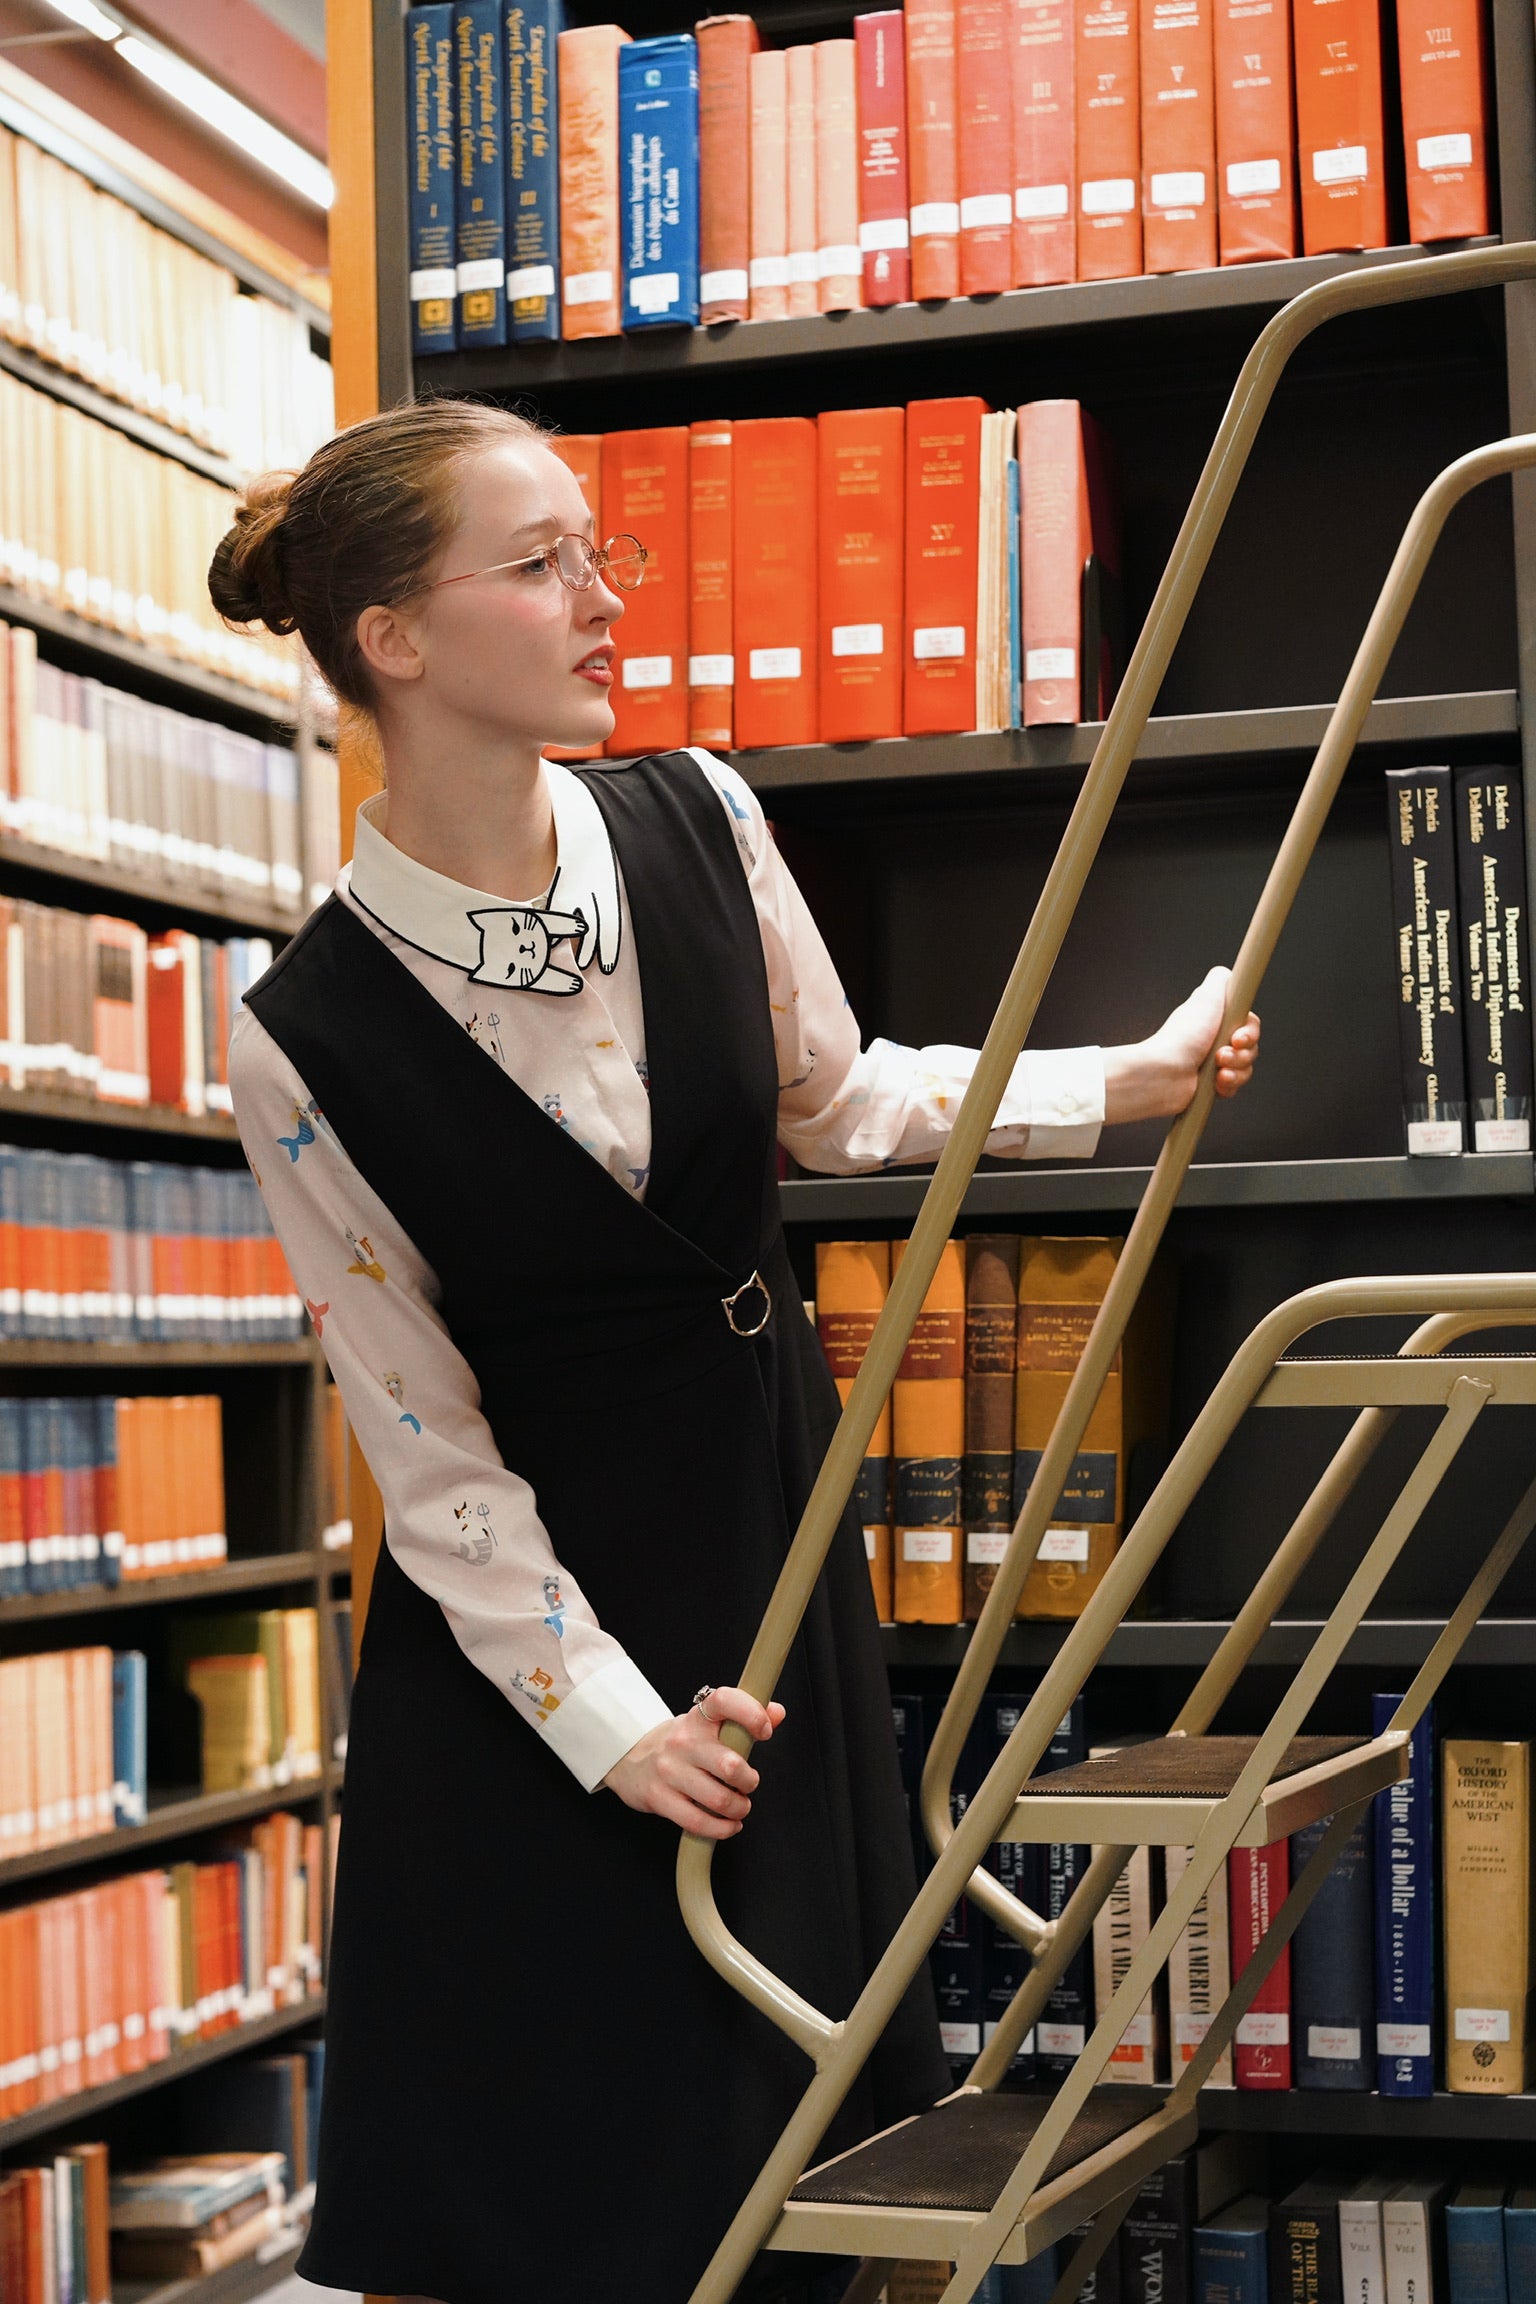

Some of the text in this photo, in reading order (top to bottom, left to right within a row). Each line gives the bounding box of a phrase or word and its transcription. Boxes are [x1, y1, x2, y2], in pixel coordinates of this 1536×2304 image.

[1425, 27, 1452, 45] VIII
[413, 22, 433, 192] North American Colonies
[432, 39, 455, 171] Encyclopedia of the
[457, 16, 475, 187] North American Colonies
[475, 32, 498, 164] Encyclopedia of the
[507, 8, 527, 179] North American Colonies
[527, 24, 549, 157] Encyclopedia of the
[663, 167, 680, 209] Canada
[930, 523, 955, 541] XV
[1424, 787, 1438, 833] Deloria
[1494, 785, 1509, 830] Deloria
[1399, 924, 1414, 1003] Volume One
[1413, 857, 1435, 1067] American Indian Diplomacy
[1435, 908, 1454, 1015] Documents of
[1469, 921, 1484, 1001] Volume Two
[1483, 854, 1504, 1066] American Indian Diplomacy
[1505, 906, 1524, 1013] Documents of
[1457, 1779, 1507, 1789] HISTORY
[1458, 1766, 1507, 1778] OXFORD
[1475, 1757, 1491, 1765] THE
[1391, 1777, 1415, 1824] Value
[1452, 1800, 1514, 1812] AMERICAN
[1467, 1812, 1500, 1822] WEST
[1391, 1827, 1414, 1846] of
[1392, 1848, 1409, 1859] a
[1050, 1874, 1066, 1918] Histo
[1111, 1872, 1131, 1917] OMEN
[1250, 1848, 1260, 1919] CAN-AMERICAN
[1391, 1863, 1415, 1917] Dollar
[1111, 1923, 1131, 1940] IN
[1189, 1922, 1209, 1939] IN
[1291, 2242, 1304, 2298] OF THE
[1305, 2243, 1318, 2275] THE
